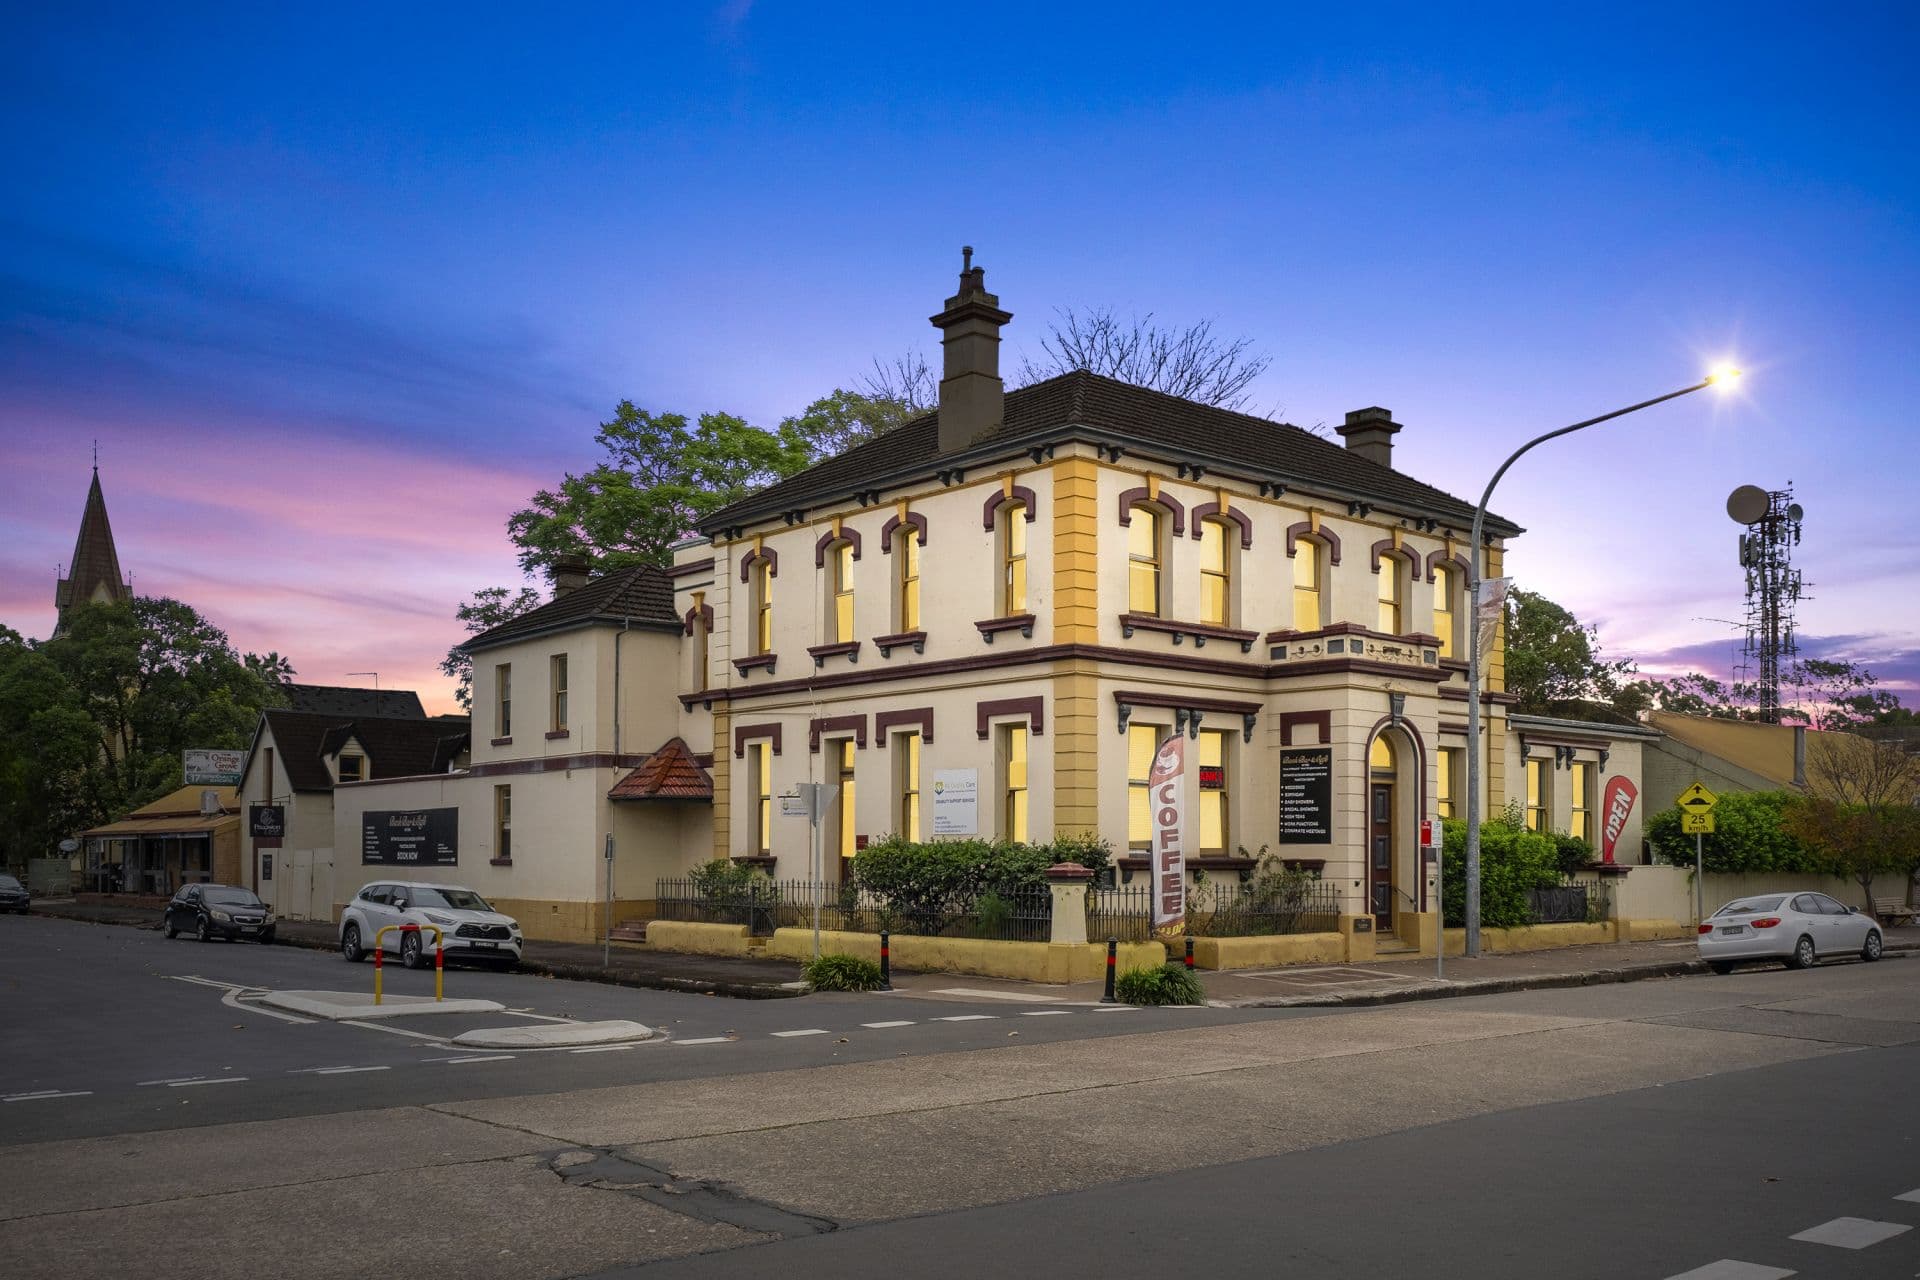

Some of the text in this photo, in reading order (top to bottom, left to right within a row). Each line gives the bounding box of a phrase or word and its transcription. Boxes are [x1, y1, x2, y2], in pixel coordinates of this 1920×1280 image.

[211, 753, 240, 765] Orange
[215, 761, 239, 770] Grove
[1606, 788, 1631, 842] OPEN
[1691, 814, 1705, 825] 25
[1689, 824, 1709, 833] km/h
[1158, 783, 1182, 915] COFFEE
[397, 851, 419, 860] BOOK NOW
